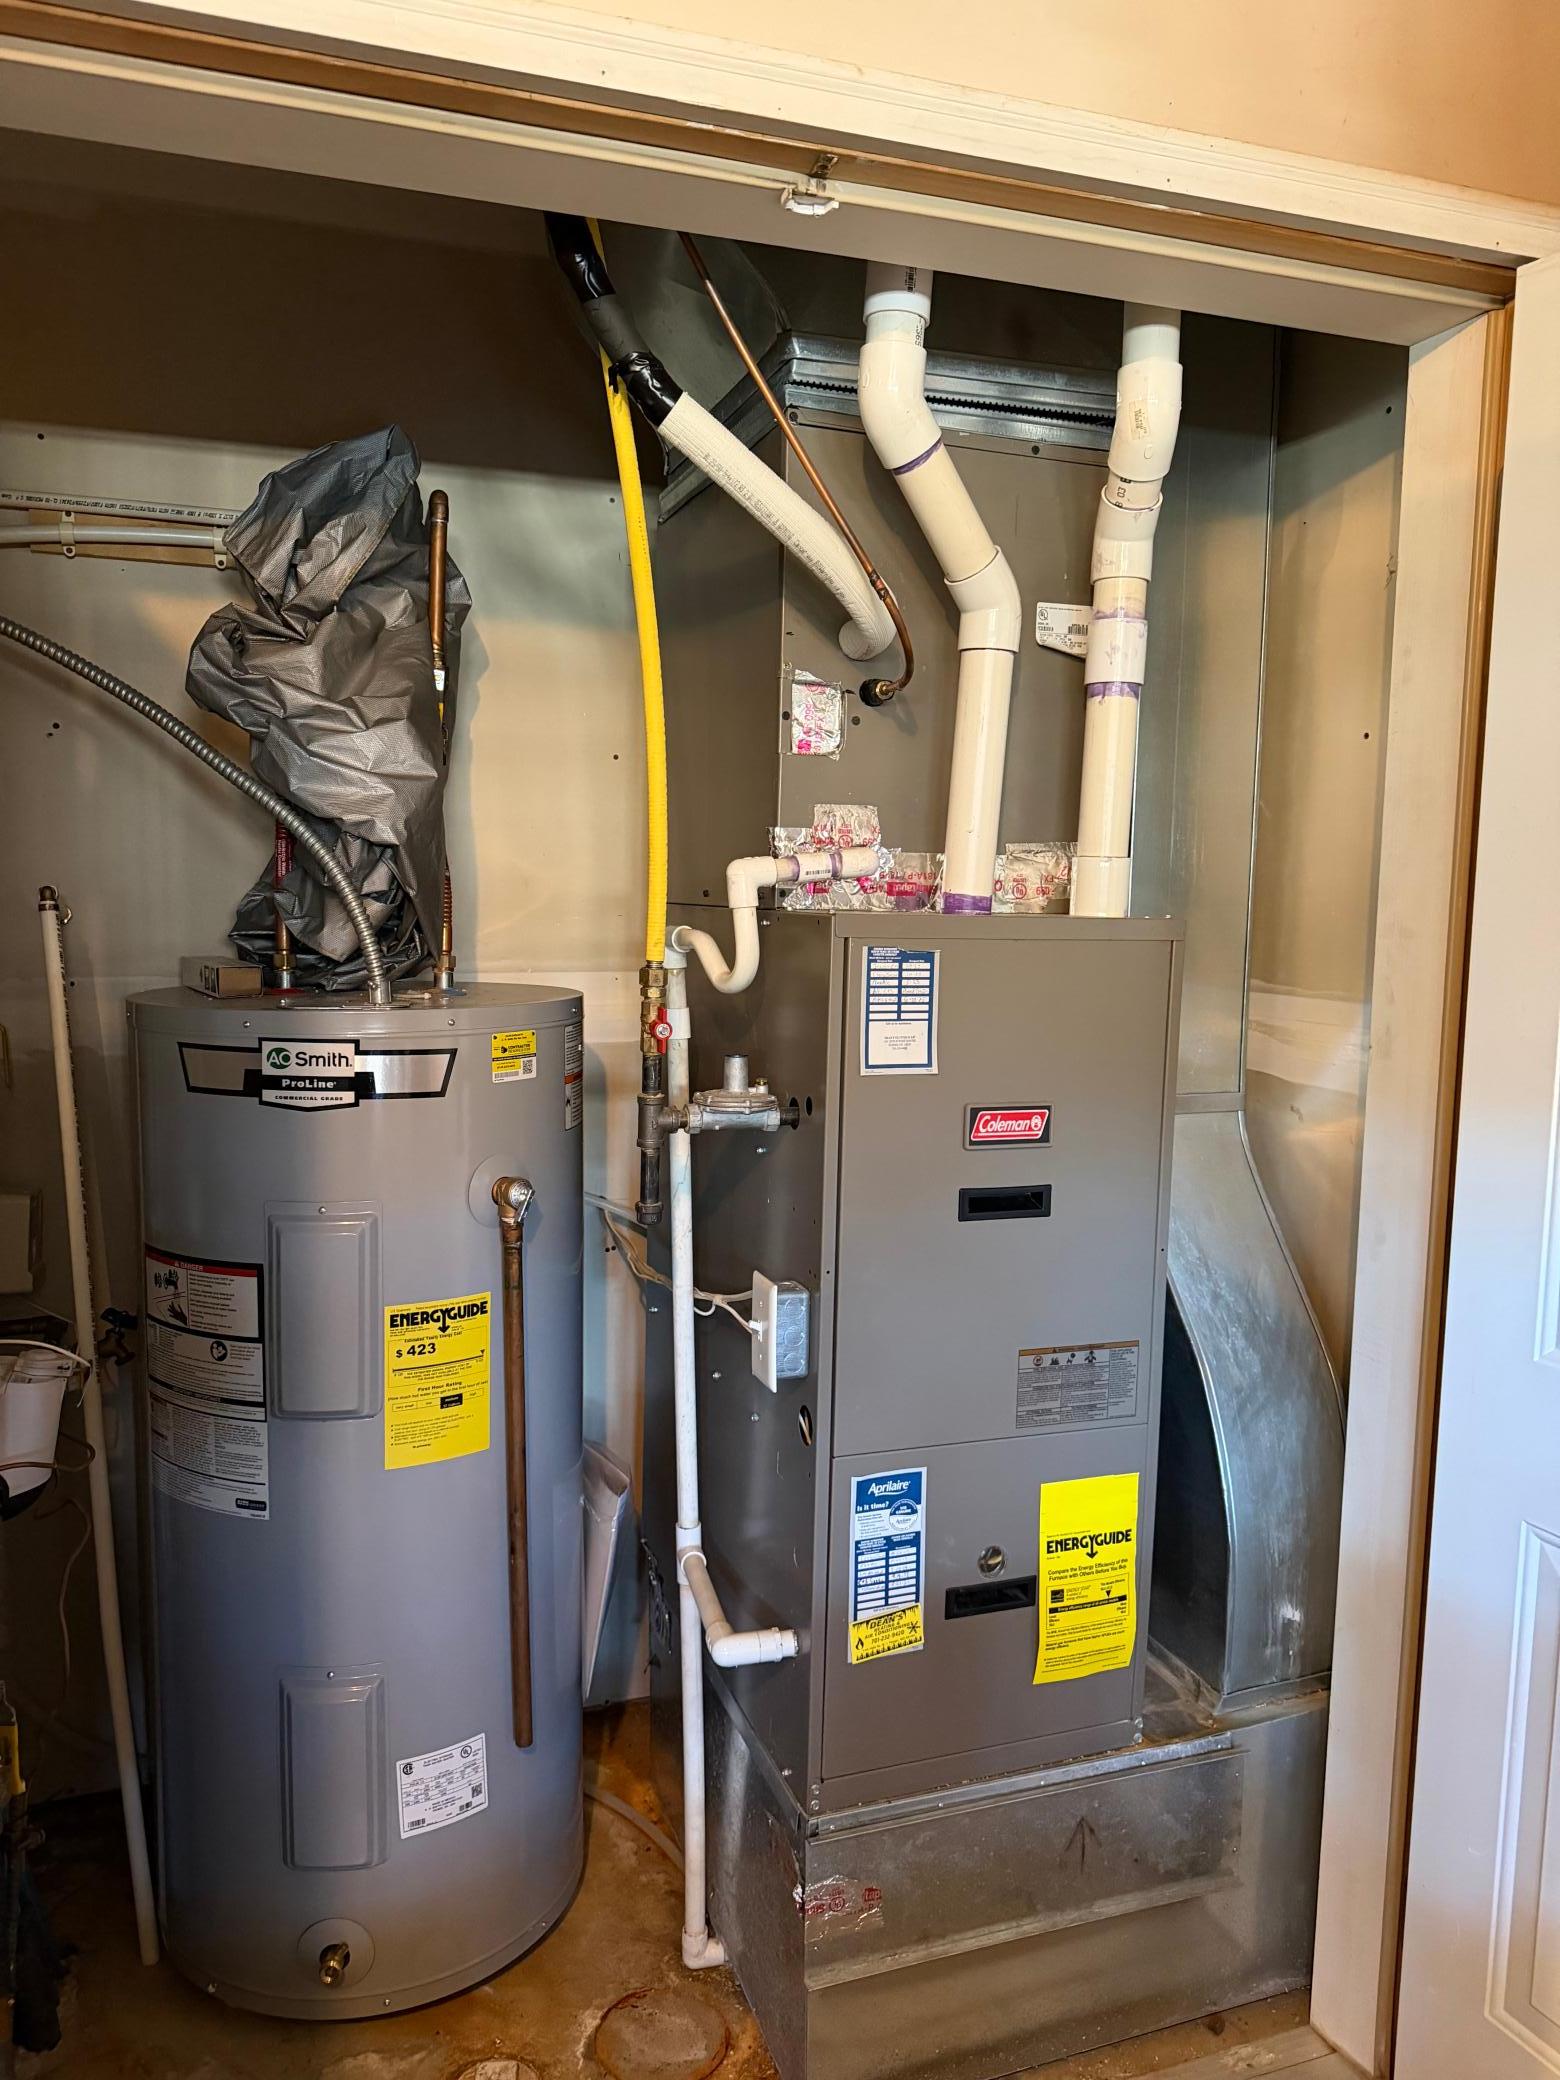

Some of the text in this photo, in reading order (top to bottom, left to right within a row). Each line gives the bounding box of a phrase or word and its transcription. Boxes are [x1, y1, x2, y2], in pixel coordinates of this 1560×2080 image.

[266, 1047, 292, 1070] AO
[979, 1115, 1030, 1133] Coleman
[181, 1262, 203, 1272] DANGER
[389, 1300, 489, 1332] ENERGYGUIDE
[396, 1342, 436, 1359] $ 423
[445, 1380, 462, 1388] Rating
[871, 1500, 889, 1509] time?
[1046, 1528, 1132, 1557] ENERGYGUIDE
[1047, 1568, 1069, 1576] Compare
[1078, 1564, 1094, 1572] Energy
[1094, 1560, 1116, 1568] Efficiency
